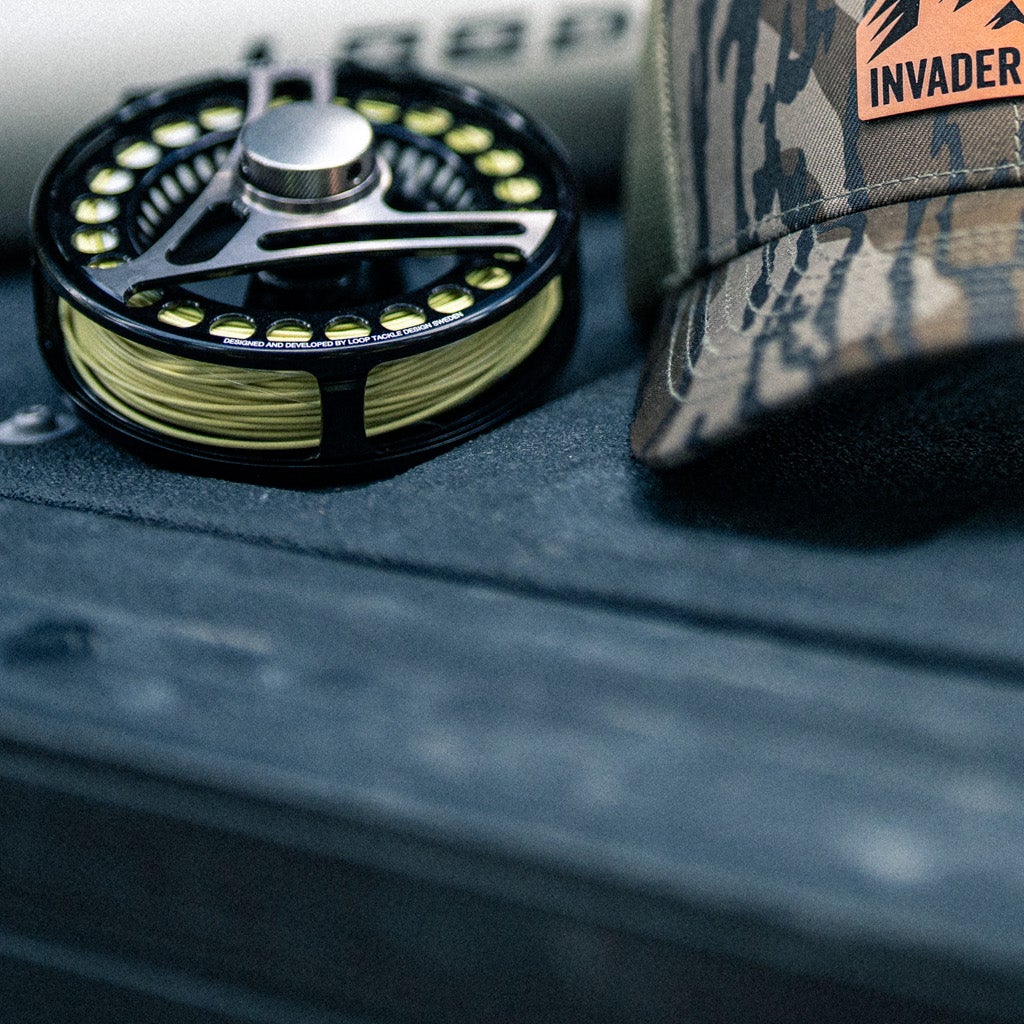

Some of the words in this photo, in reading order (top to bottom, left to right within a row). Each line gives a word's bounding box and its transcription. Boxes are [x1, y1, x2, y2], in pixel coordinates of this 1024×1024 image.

[245, 2, 634, 74] OOP
[869, 46, 1022, 109] INVADER
[222, 337, 265, 347] DESIGNED
[285, 341, 334, 349] DEVELOPED
[348, 336, 371, 345] LOOP
[371, 330, 403, 342] TACKLE
[403, 323, 432, 335] DESIGN
[432, 312, 464, 327] SWEDEN
